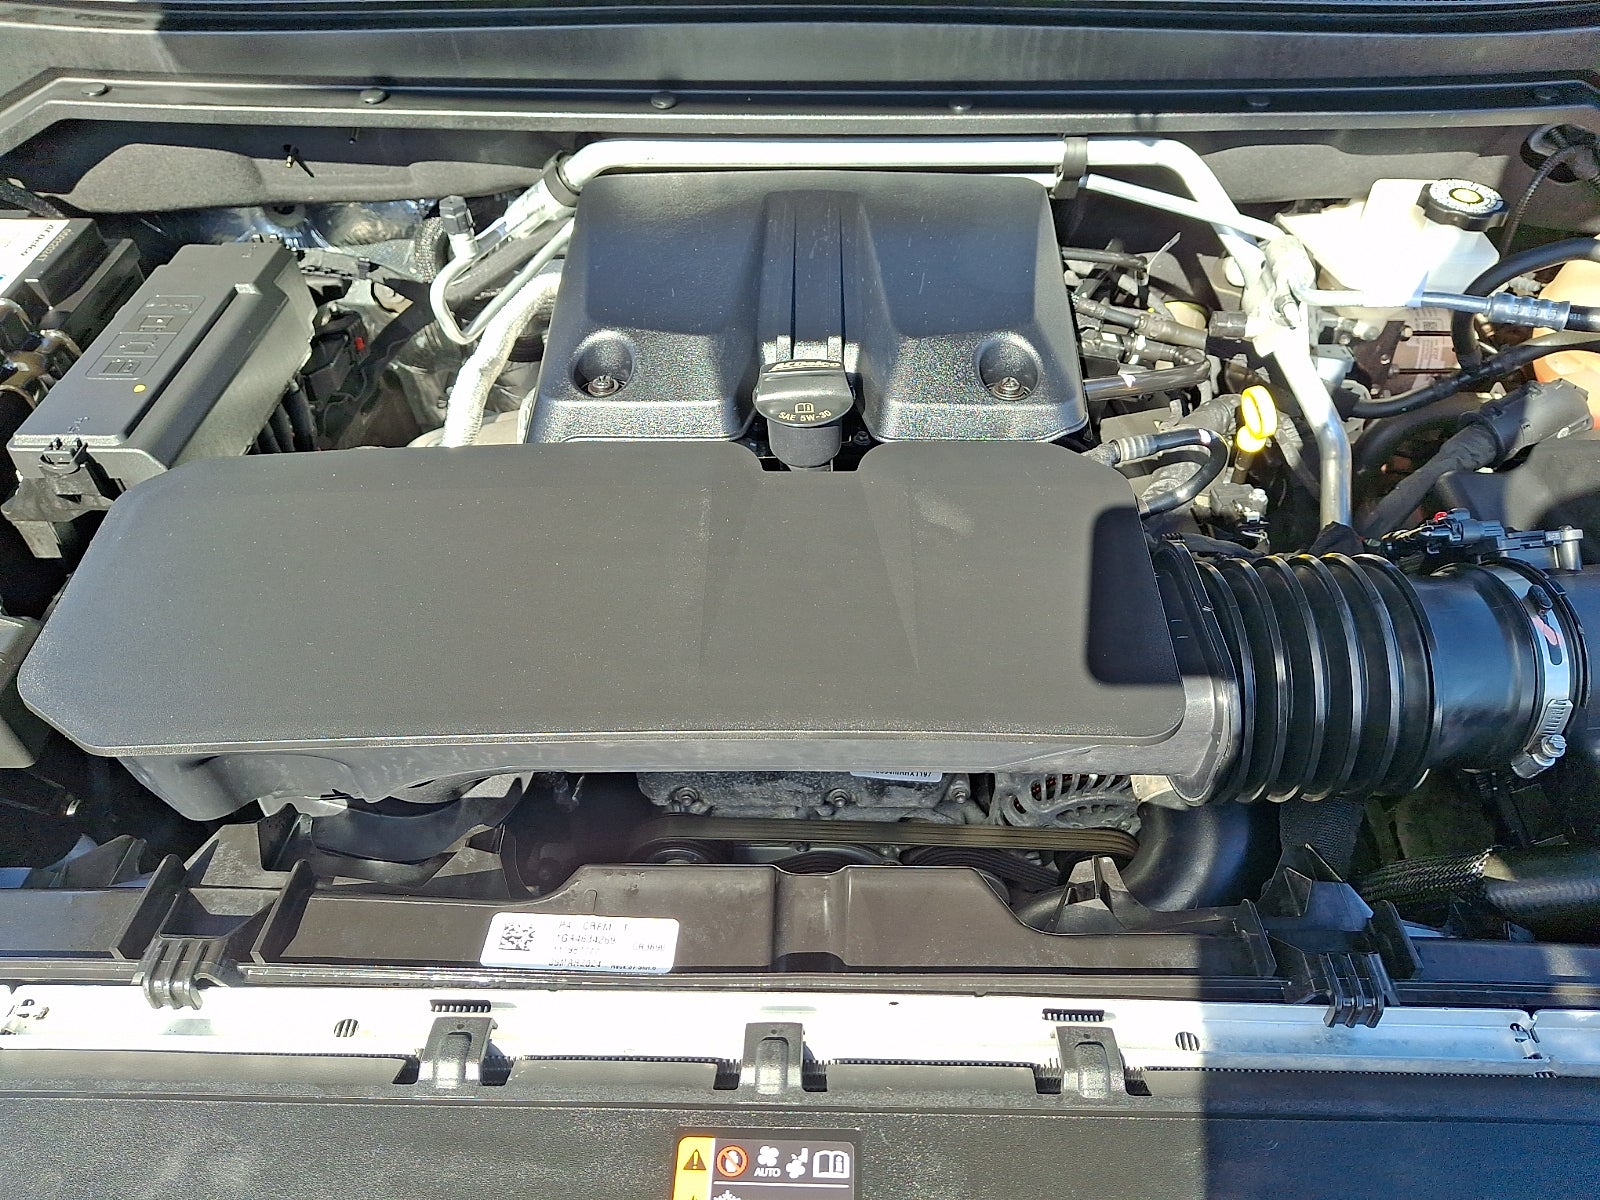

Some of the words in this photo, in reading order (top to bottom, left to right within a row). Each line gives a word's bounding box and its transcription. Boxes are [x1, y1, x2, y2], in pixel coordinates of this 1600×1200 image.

[778, 411, 796, 421] SAE
[800, 410, 832, 422] 5W-30
[753, 1167, 781, 1178] AUTO
